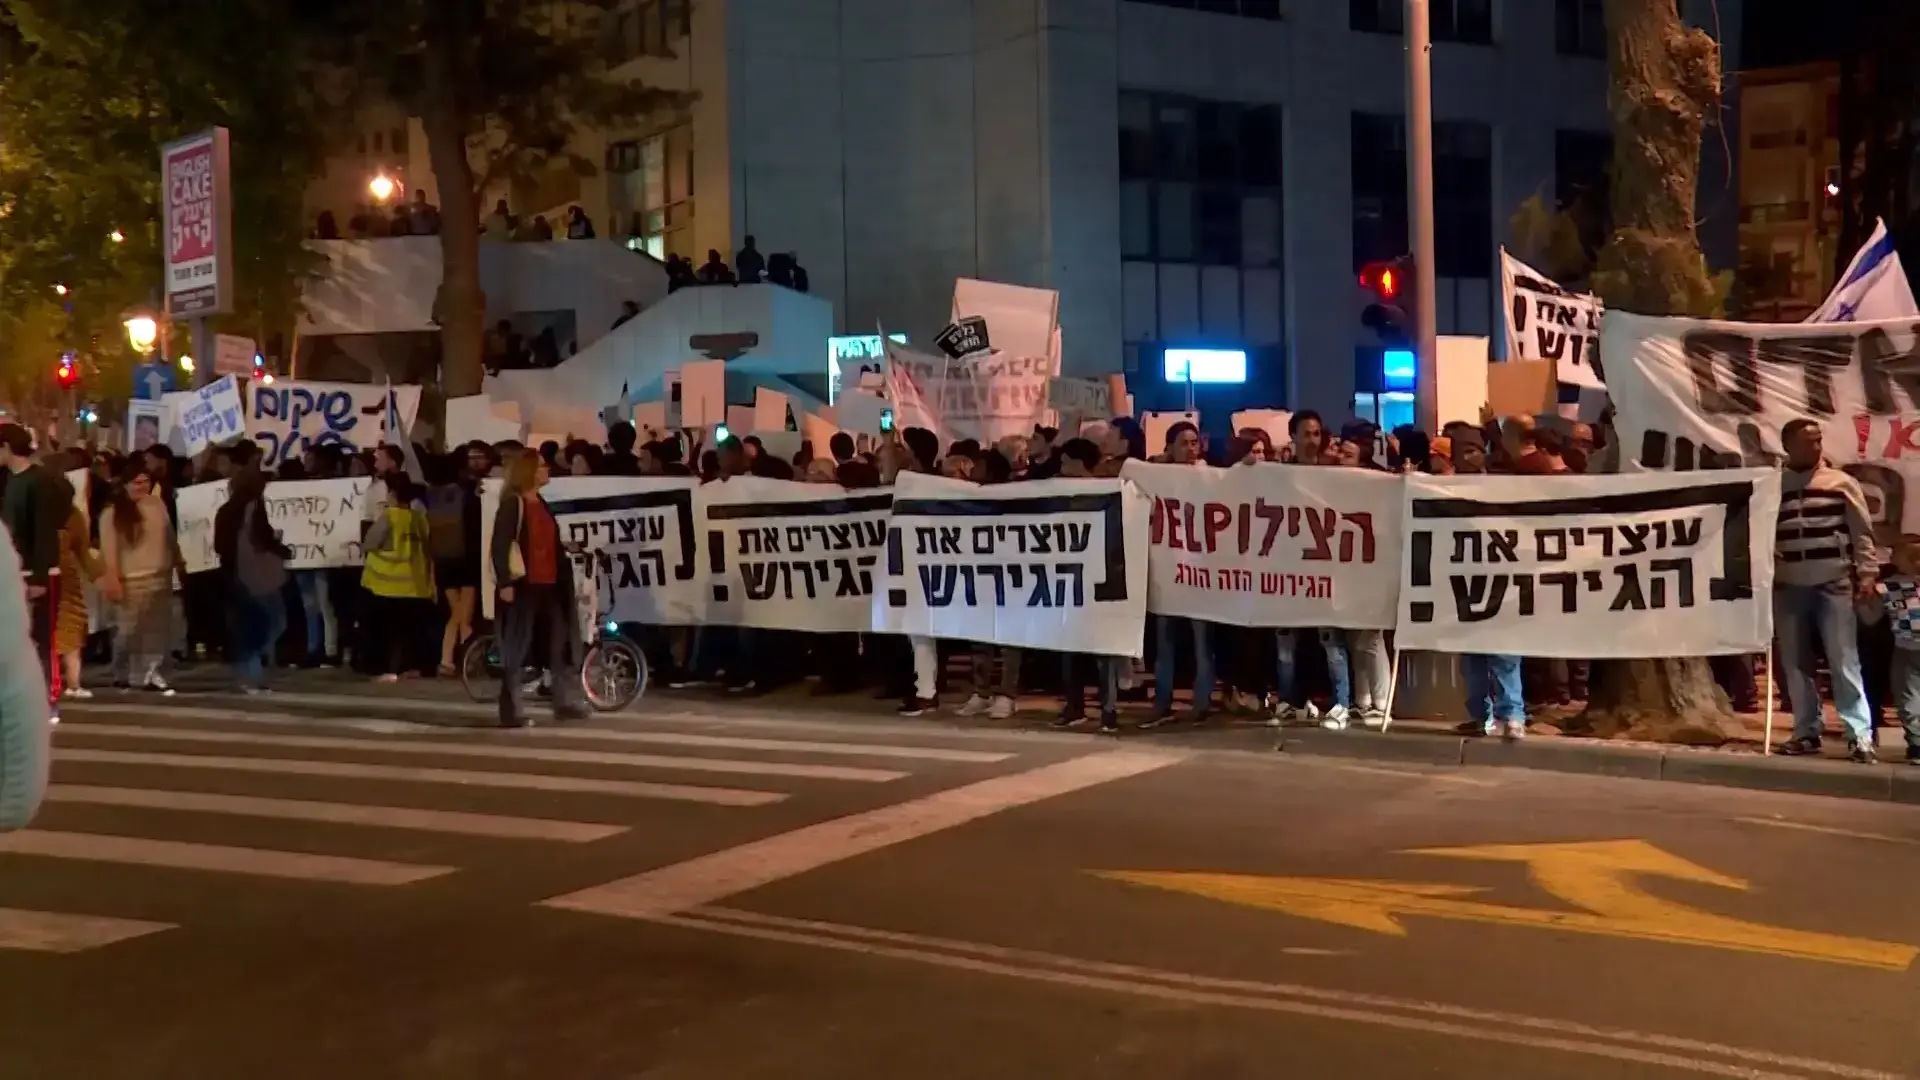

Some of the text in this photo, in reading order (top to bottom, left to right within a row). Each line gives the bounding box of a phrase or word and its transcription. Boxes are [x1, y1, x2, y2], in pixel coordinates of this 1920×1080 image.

[171, 173, 212, 206] CAKE
[1535, 300, 1578, 327] את
[254, 387, 358, 431] שיקום
[308, 518, 335, 537] על
[569, 515, 664, 548] עוצרים
[738, 519, 887, 554] עוצרים את
[915, 523, 1091, 554] עוצרים את
[1238, 497, 1375, 563] הצילו
[1450, 517, 1702, 562] עוצרים את
[918, 563, 1084, 607] הגירוש
[1175, 563, 1332, 598] הגירוש הזה הורג
[1450, 557, 1694, 622] הגירוש
